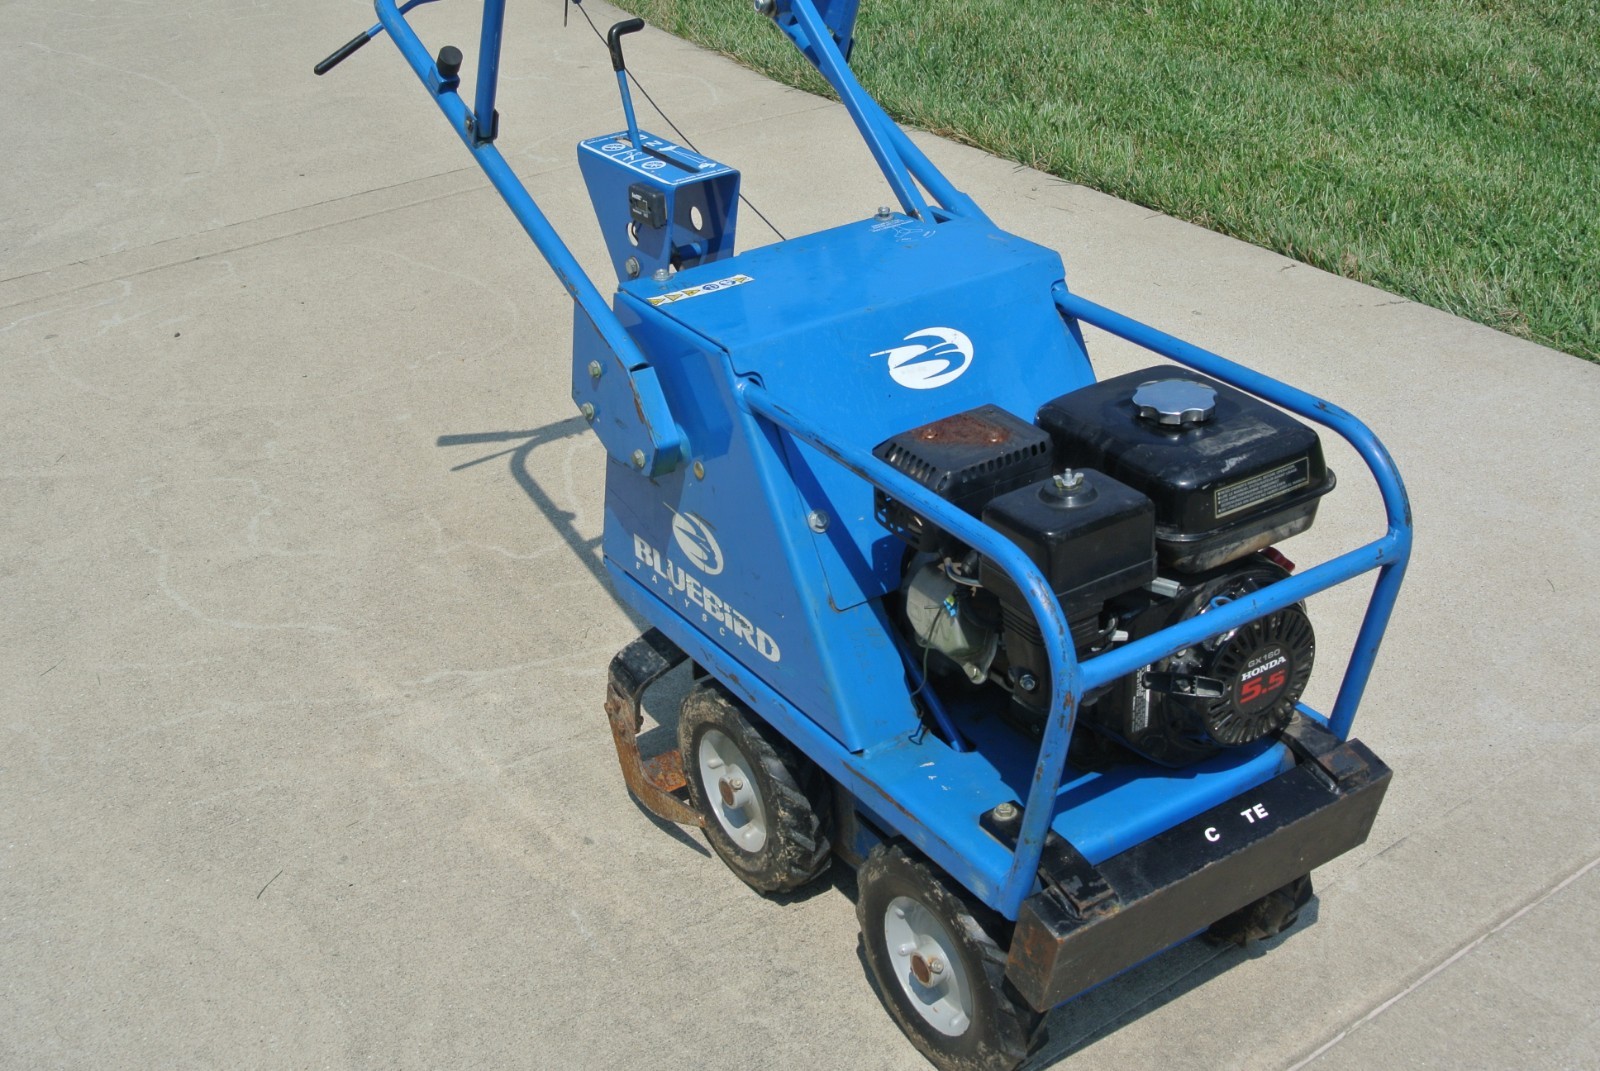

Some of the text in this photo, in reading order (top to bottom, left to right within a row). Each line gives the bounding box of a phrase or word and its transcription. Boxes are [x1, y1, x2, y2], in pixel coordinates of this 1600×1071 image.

[1241, 656, 1286, 682] HONDA
[1240, 669, 1285, 704] 5.5
[1240, 804, 1269, 824] TE
